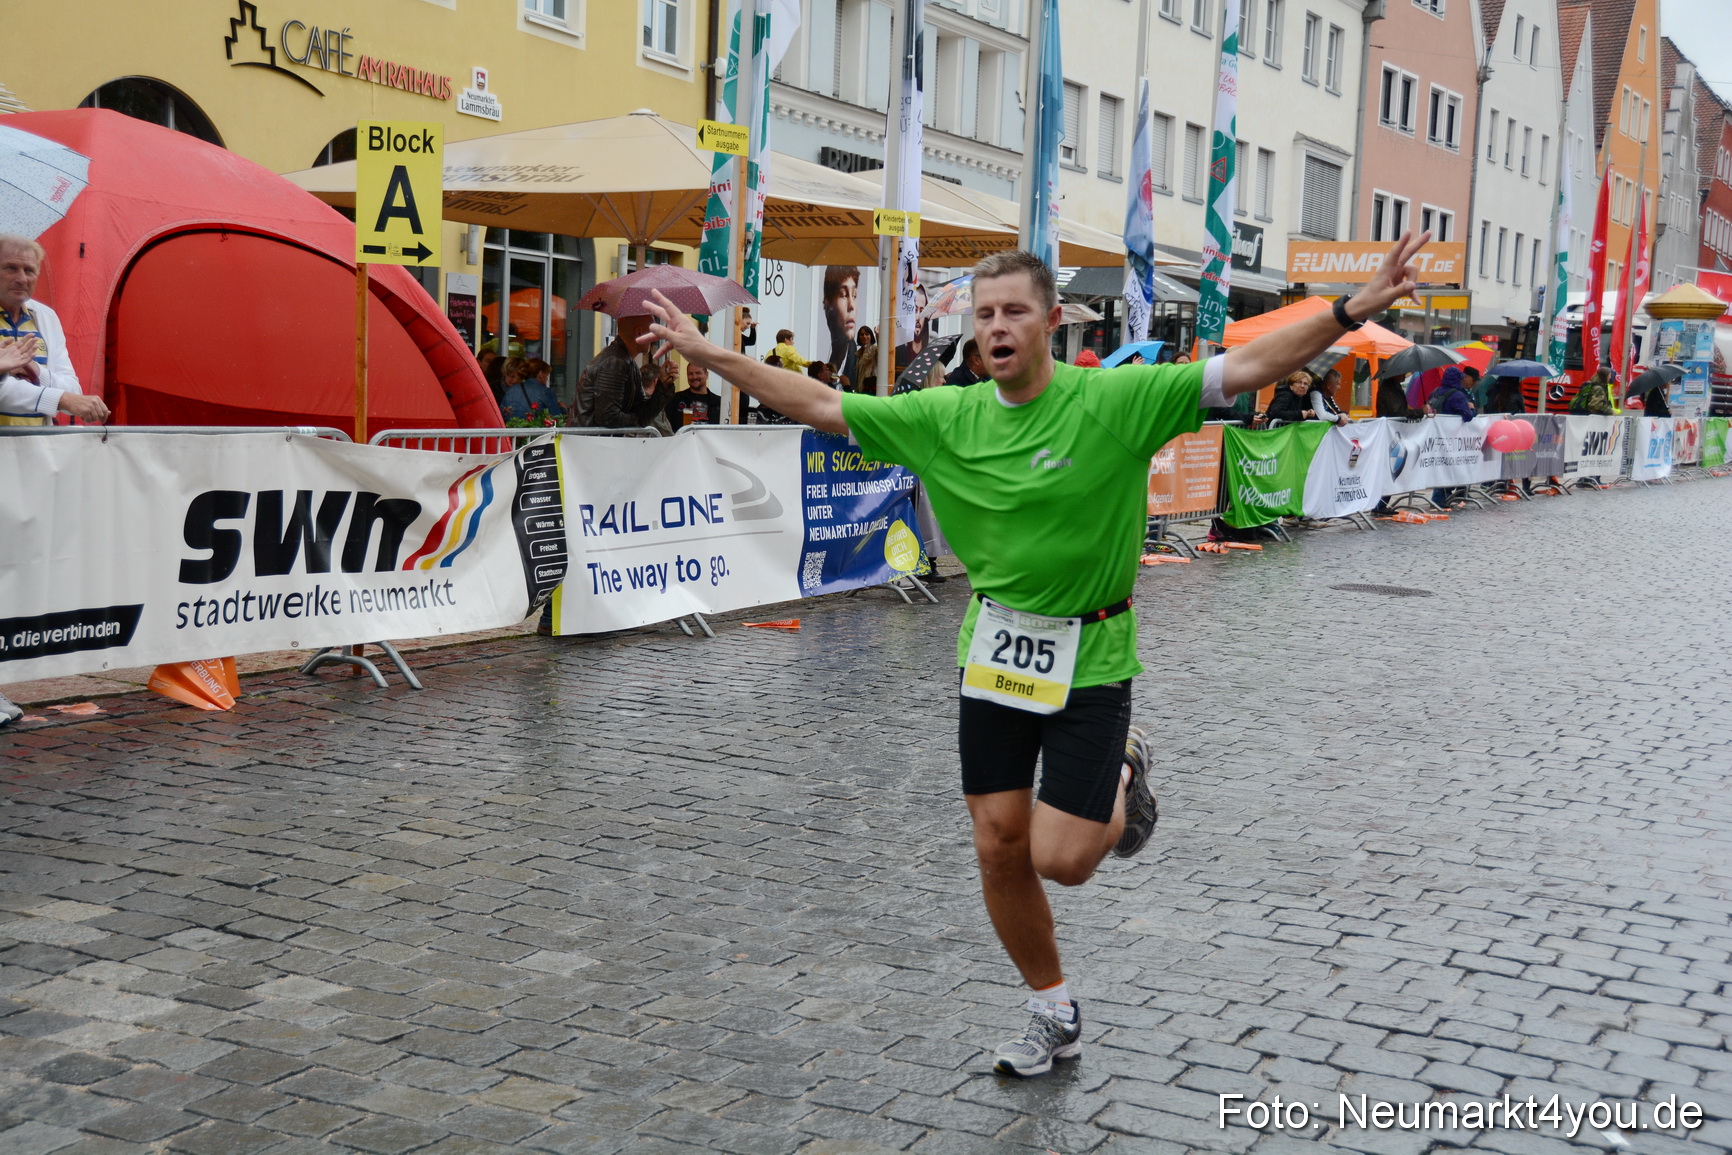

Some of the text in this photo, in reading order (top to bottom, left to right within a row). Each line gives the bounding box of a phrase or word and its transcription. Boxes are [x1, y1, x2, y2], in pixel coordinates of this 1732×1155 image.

[282, 19, 353, 76] CAFÉ
[357, 55, 453, 101] AM RATHAUS
[461, 98, 500, 118] Lammsbräu
[368, 125, 435, 155] Block
[706, 124, 749, 141] Startnummern-
[715, 140, 740, 152] ausgabe
[373, 164, 425, 235] A
[888, 224, 907, 234] ausgab
[806, 451, 826, 474] WIR
[529, 494, 552, 504] Wasser
[806, 483, 828, 500] FREIE
[807, 504, 834, 521] UNTER
[535, 520, 556, 529] Wärme
[539, 543, 558, 553] Freizeit
[538, 567, 563, 578] Stadtbusse
[587, 554, 730, 595] The way to go.
[176, 578, 457, 629] stadtwerke neumarkt
[12, 630, 41, 649] die
[43, 620, 121, 644] verbinden
[990, 629, 1056, 674] 205
[995, 674, 1035, 697] Bernd
